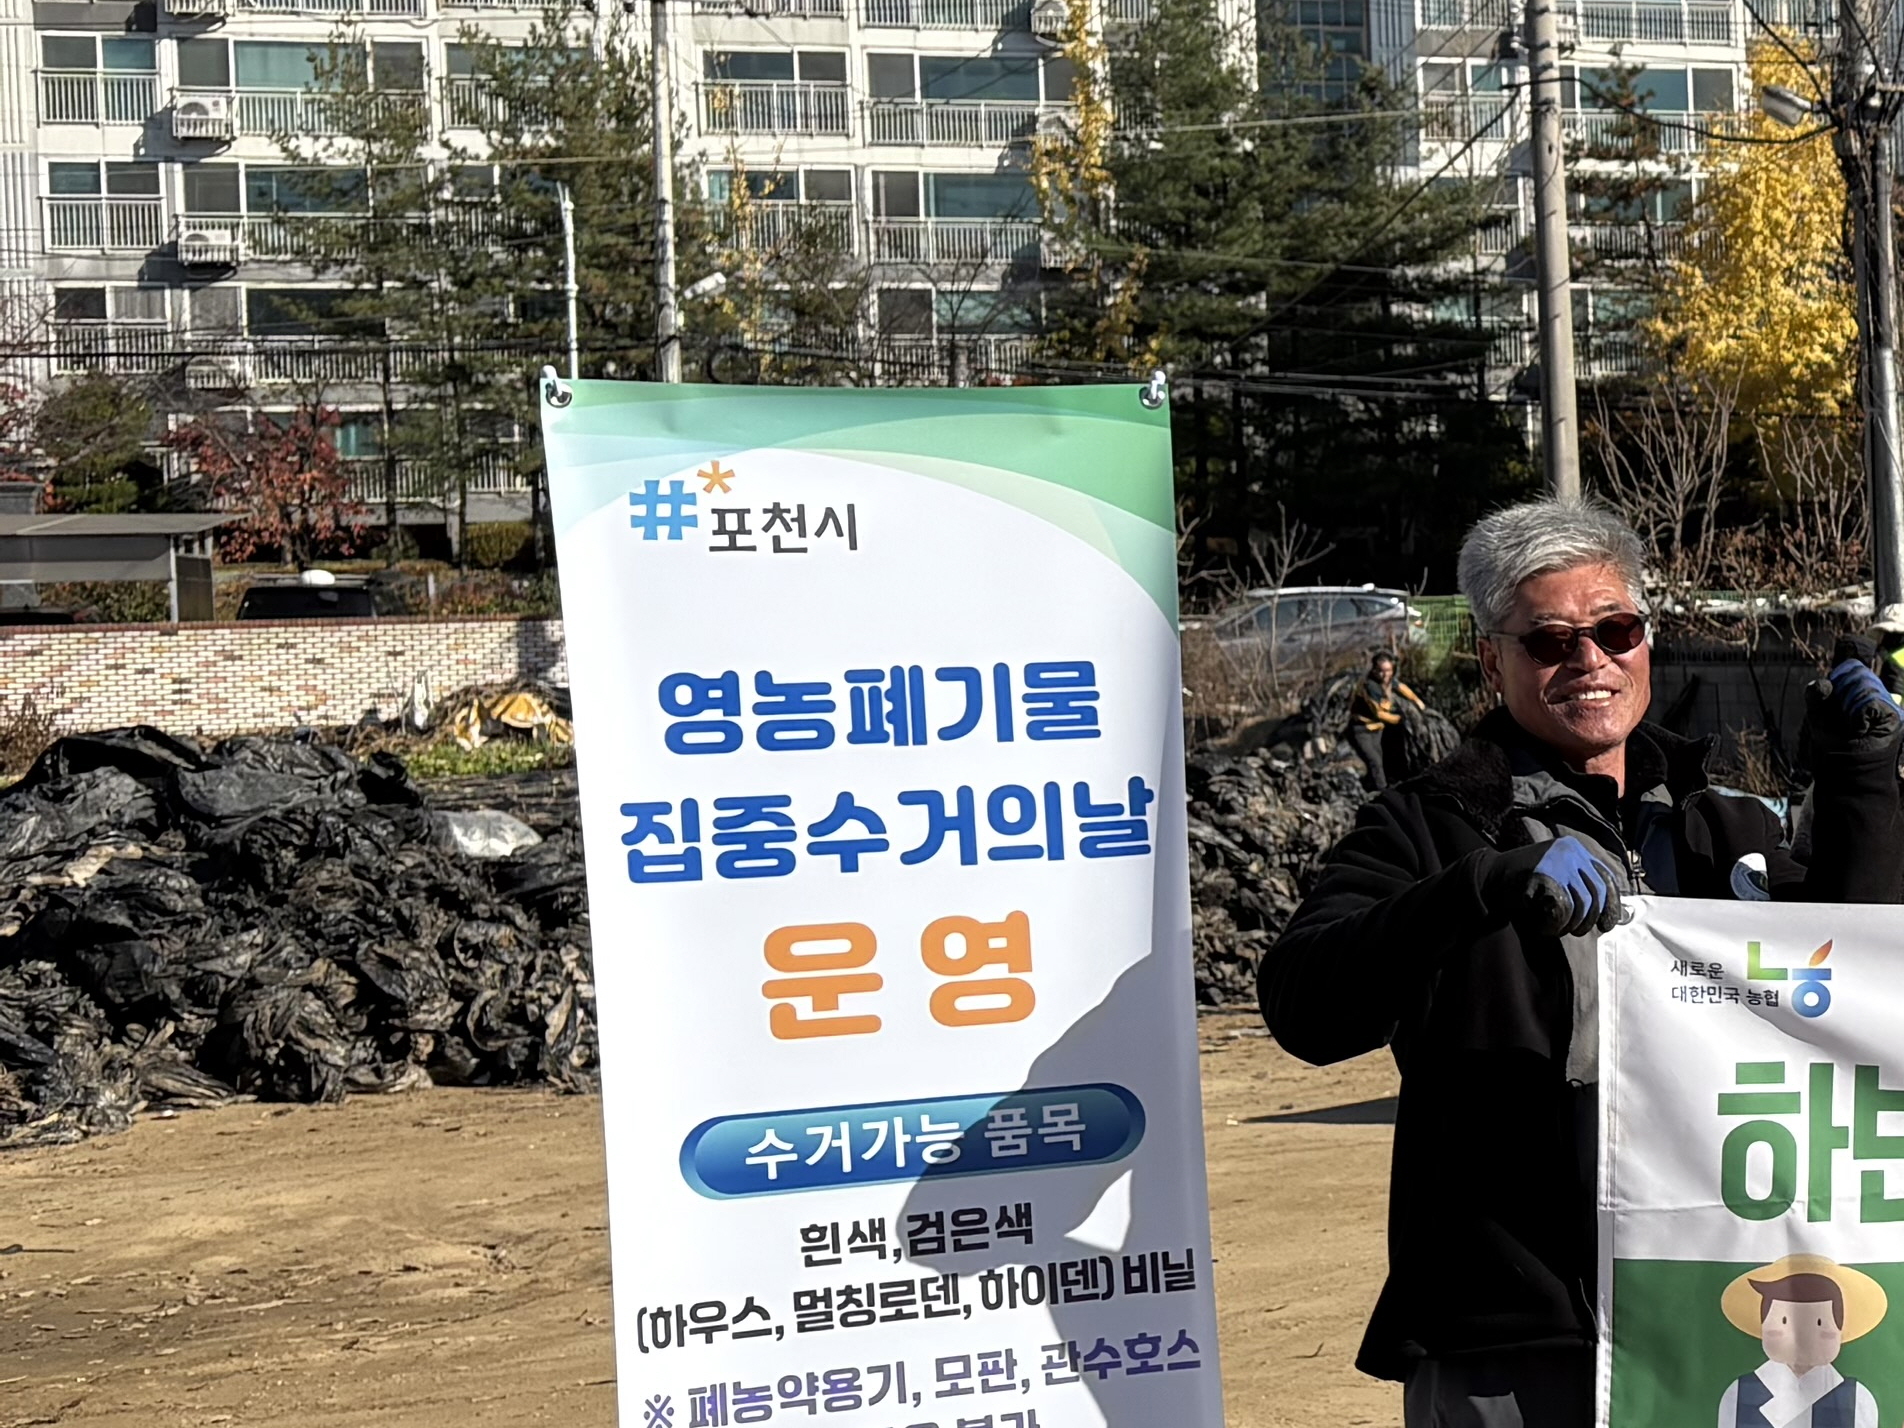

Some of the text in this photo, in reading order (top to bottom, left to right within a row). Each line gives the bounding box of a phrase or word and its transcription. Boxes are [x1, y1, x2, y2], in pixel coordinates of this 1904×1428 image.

[709, 502, 857, 554] 포천시
[658, 660, 1102, 756] 영농폐기물
[619, 776, 1156, 885] 집중수거의날
[1670, 960, 1725, 980] 새로운
[1671, 985, 1779, 1007] 대한민국 농협
[745, 1102, 1087, 1179] 수거가능 품목
[636, 1294, 784, 1354] (하우스,
[793, 1274, 972, 1335] 멀칭로덴,
[1123, 1248, 1197, 1295] 비닐
[934, 1349, 1030, 1400] 모판,
[1040, 1329, 1203, 1387] 관수호스
